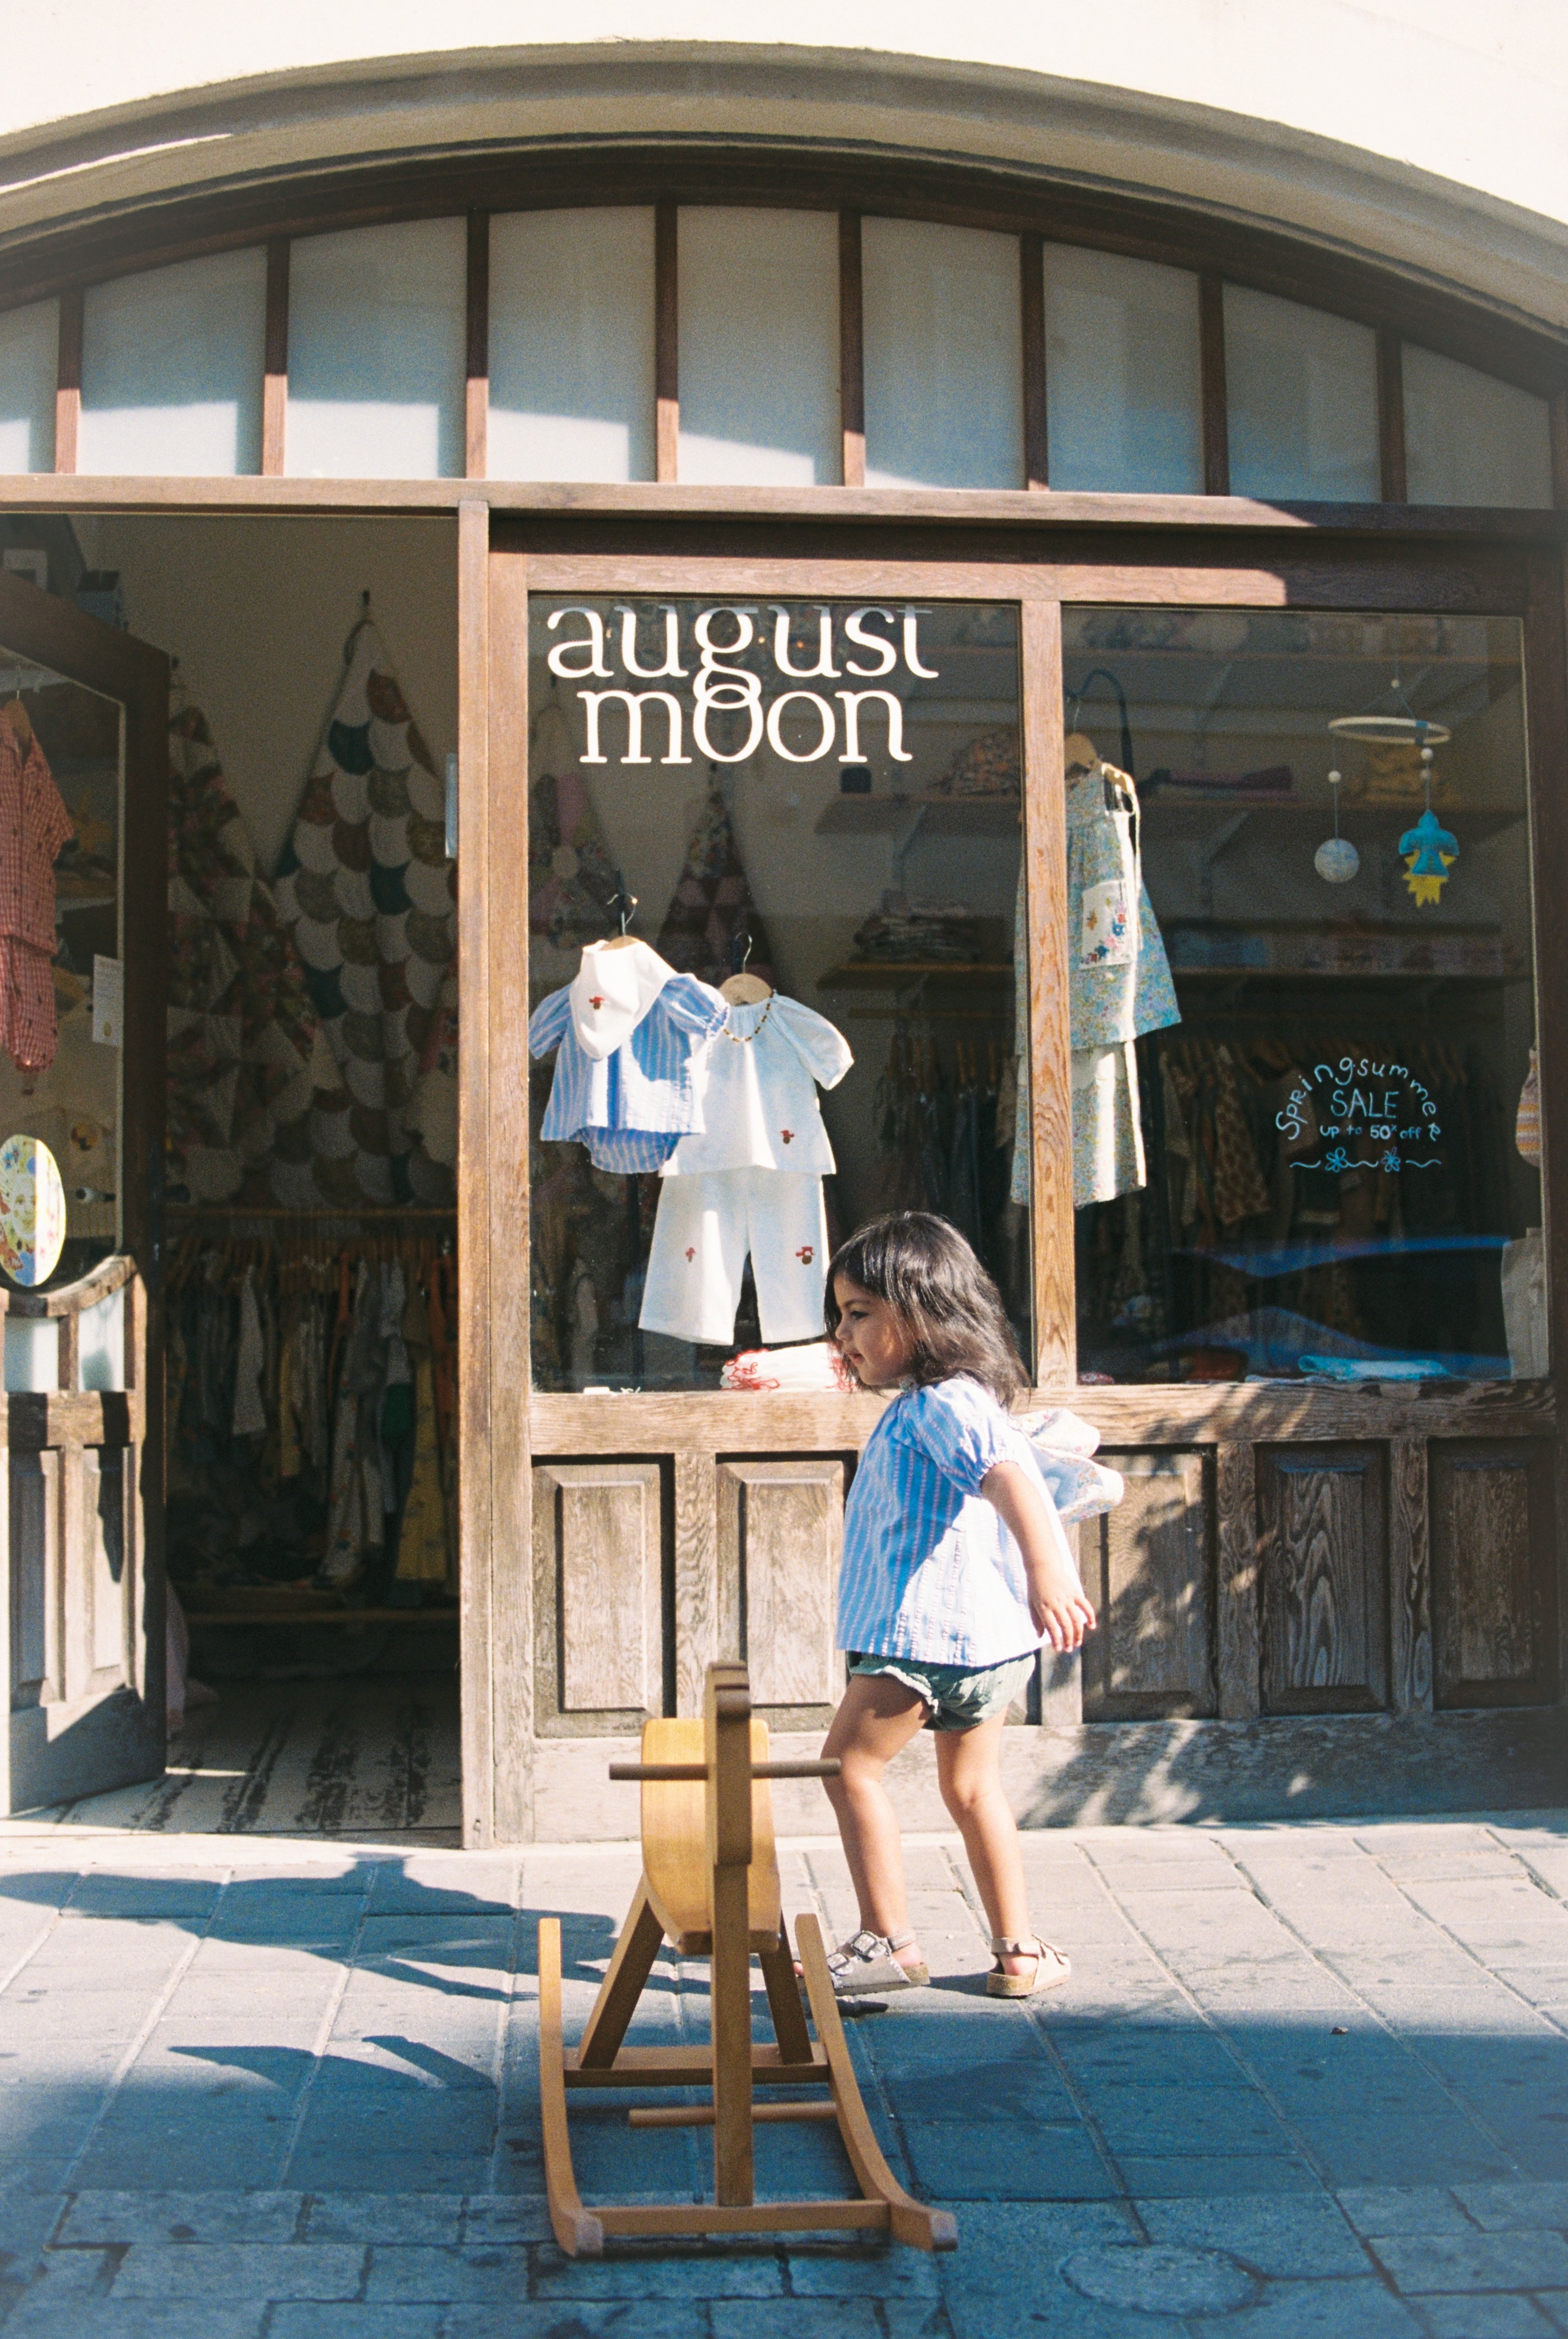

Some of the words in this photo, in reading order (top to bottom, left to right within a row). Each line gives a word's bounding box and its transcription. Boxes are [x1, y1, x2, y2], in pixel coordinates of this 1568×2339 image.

[547, 605, 939, 701] august
[576, 683, 913, 763] moon
[1331, 1088, 1400, 1118] SALE
[1320, 1125, 1341, 1139] up
[1346, 1124, 1363, 1135] to
[1399, 1126, 1422, 1139] off
